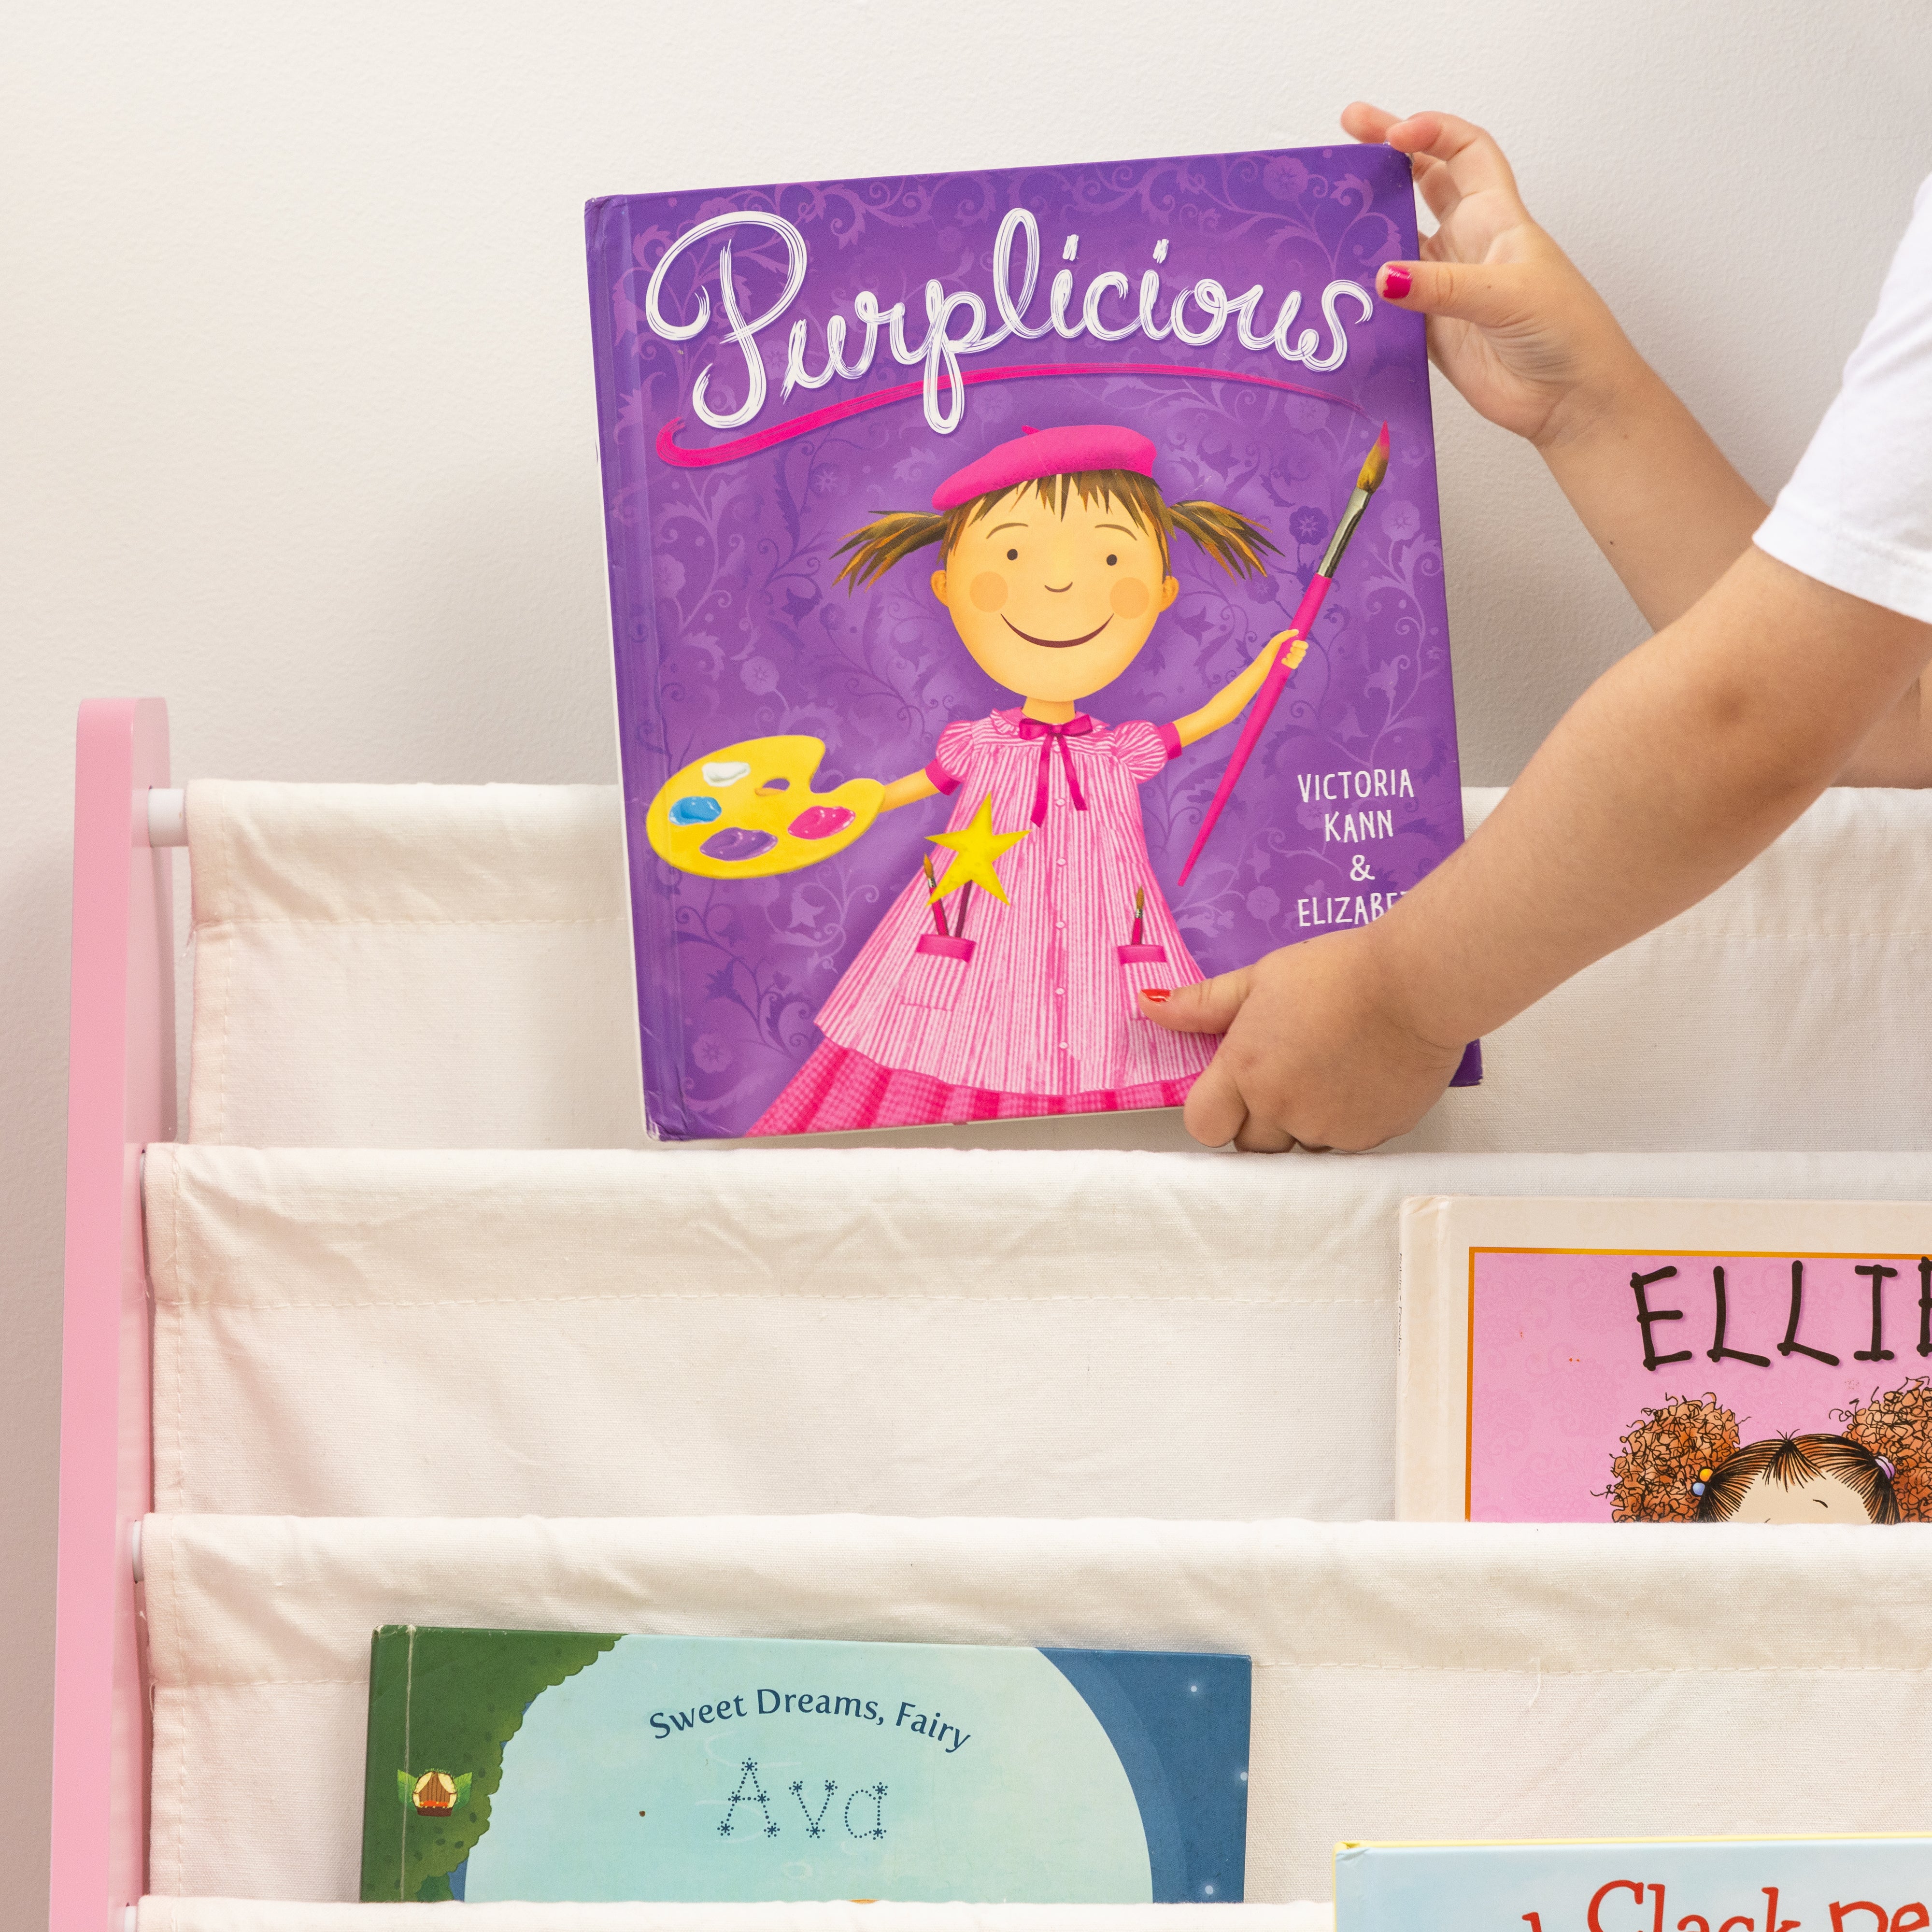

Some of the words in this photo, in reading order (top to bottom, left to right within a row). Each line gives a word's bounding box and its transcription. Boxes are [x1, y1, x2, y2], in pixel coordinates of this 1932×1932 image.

[645, 207, 1374, 434] Purplicious
[1297, 768, 1415, 803] VICTORIA
[1324, 810, 1394, 843] KANN
[1350, 854, 1376, 881] &
[1297, 891, 1408, 927] ELIZABE
[650, 1695, 748, 1739] Sweet
[757, 1689, 884, 1726] Dreams,
[895, 1702, 971, 1753] Fairy
[717, 1757, 888, 1841] Ava
